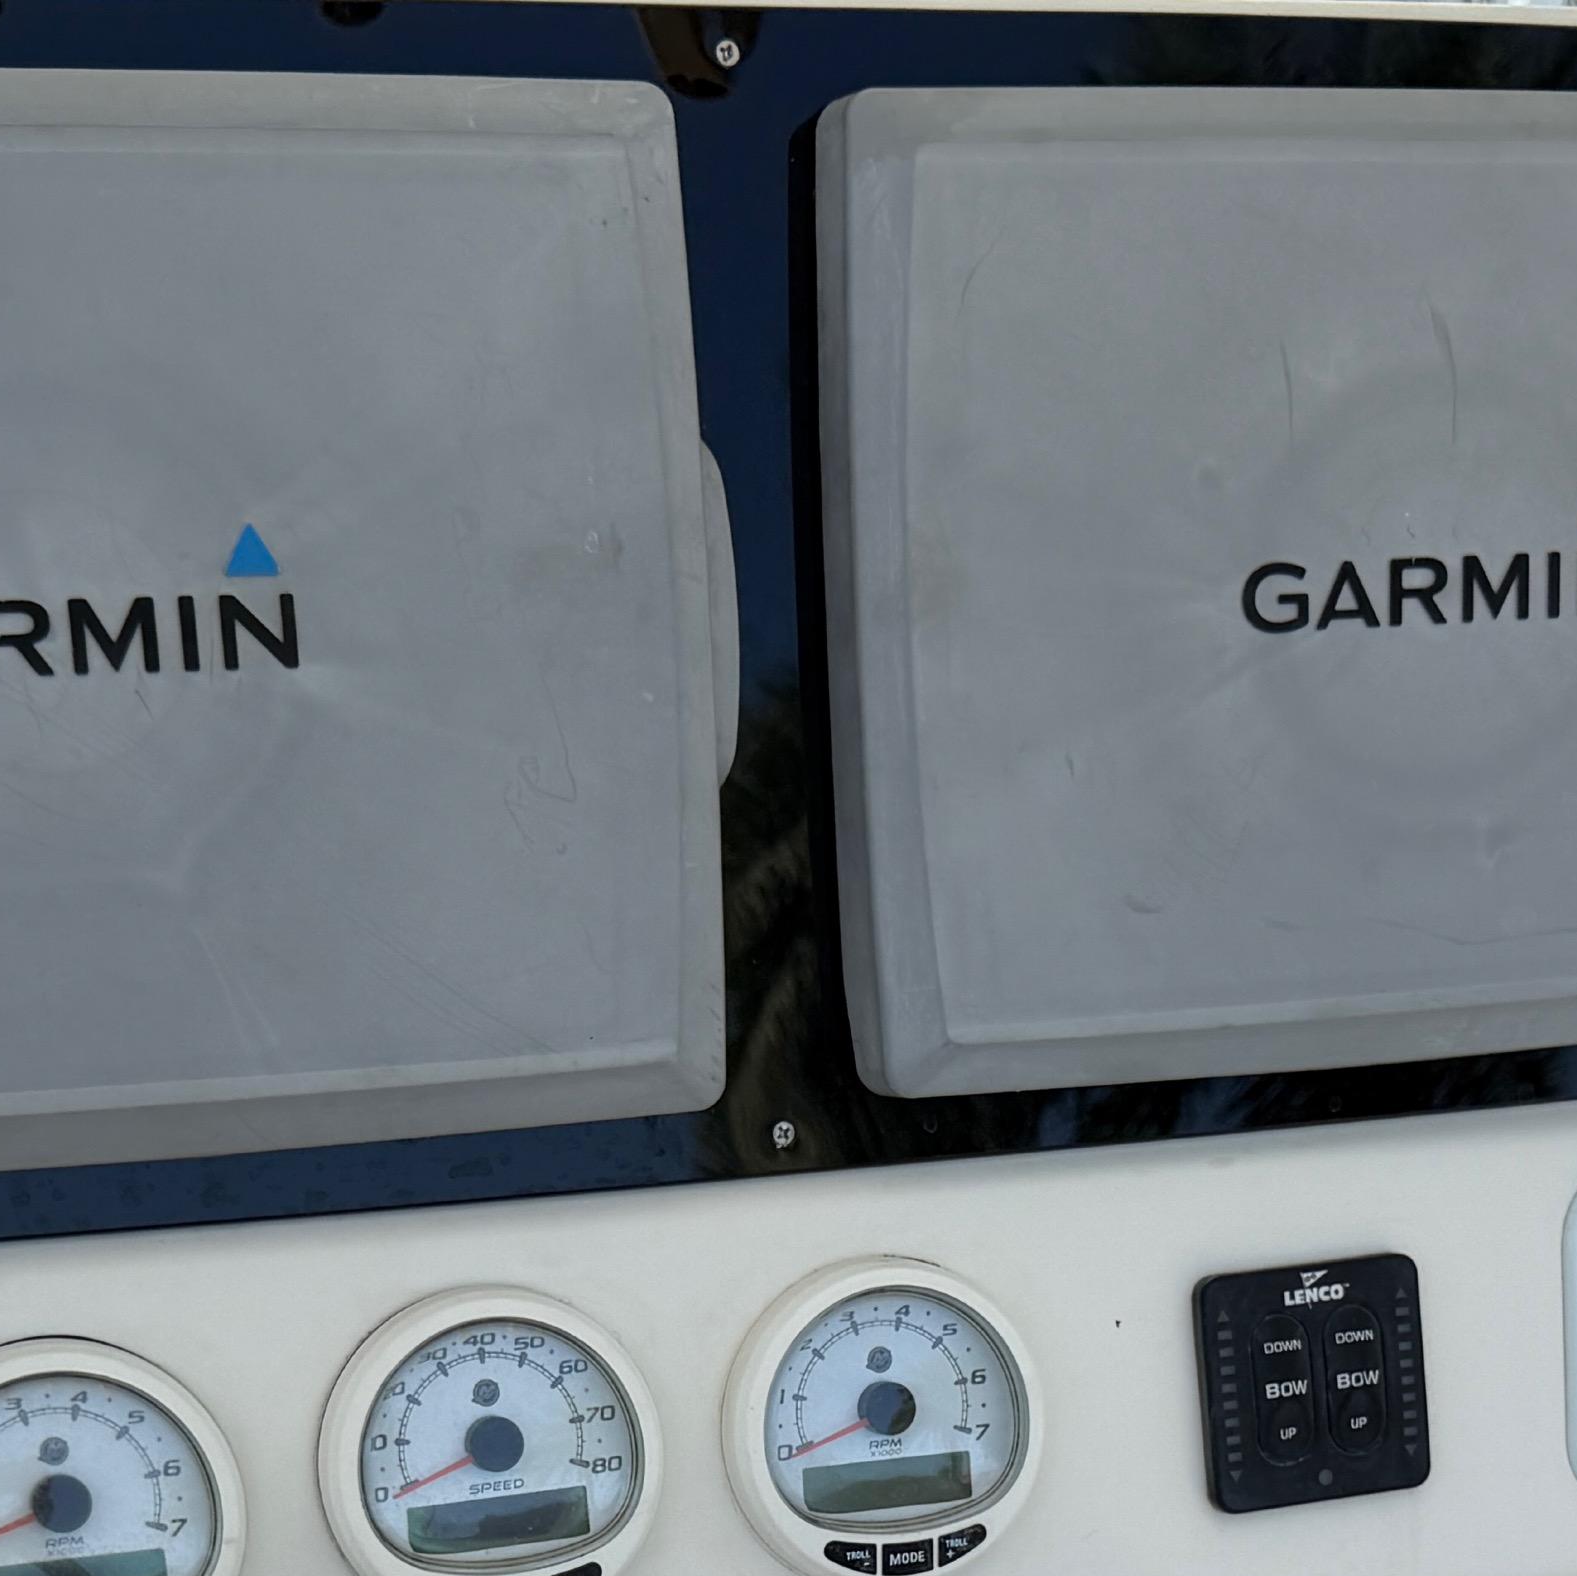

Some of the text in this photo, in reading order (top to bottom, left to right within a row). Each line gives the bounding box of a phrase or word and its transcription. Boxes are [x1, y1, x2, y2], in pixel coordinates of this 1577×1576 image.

[1284, 1283, 1345, 1308] LENCO
[840, 1310, 855, 1322] 3
[895, 1304, 911, 1318] 4
[942, 1323, 958, 1337] 5
[1335, 1330, 1374, 1344] DOWN
[463, 1332, 496, 1347] 40
[514, 1335, 545, 1350] 50
[800, 1338, 813, 1351] 2
[1264, 1339, 1302, 1354] DOWN
[418, 1347, 447, 1364] 30
[558, 1359, 589, 1374] 60
[971, 1369, 986, 1385] 6
[1336, 1370, 1379, 1389] BOW
[1266, 1380, 1308, 1399] BOW
[4, 1397, 24, 1411] 3
[70, 1391, 89, 1404] 4
[127, 1410, 145, 1425] 5
[585, 1405, 616, 1422] 70
[1350, 1416, 1368, 1429] UP
[974, 1424, 990, 1440] 7
[1280, 1427, 1297, 1440] UP
[869, 1438, 903, 1449] RPM
[777, 1445, 793, 1461] 0
[162, 1460, 182, 1478] 6
[591, 1456, 623, 1474] 80
[469, 1478, 525, 1495] SPEED
[374, 1487, 388, 1503] 0
[168, 1518, 189, 1537] 7
[45, 1535, 85, 1548] RPM
[945, 1537, 968, 1548] TROLL
[846, 1550, 871, 1561] TROLL
[889, 1550, 926, 1566] MODE
